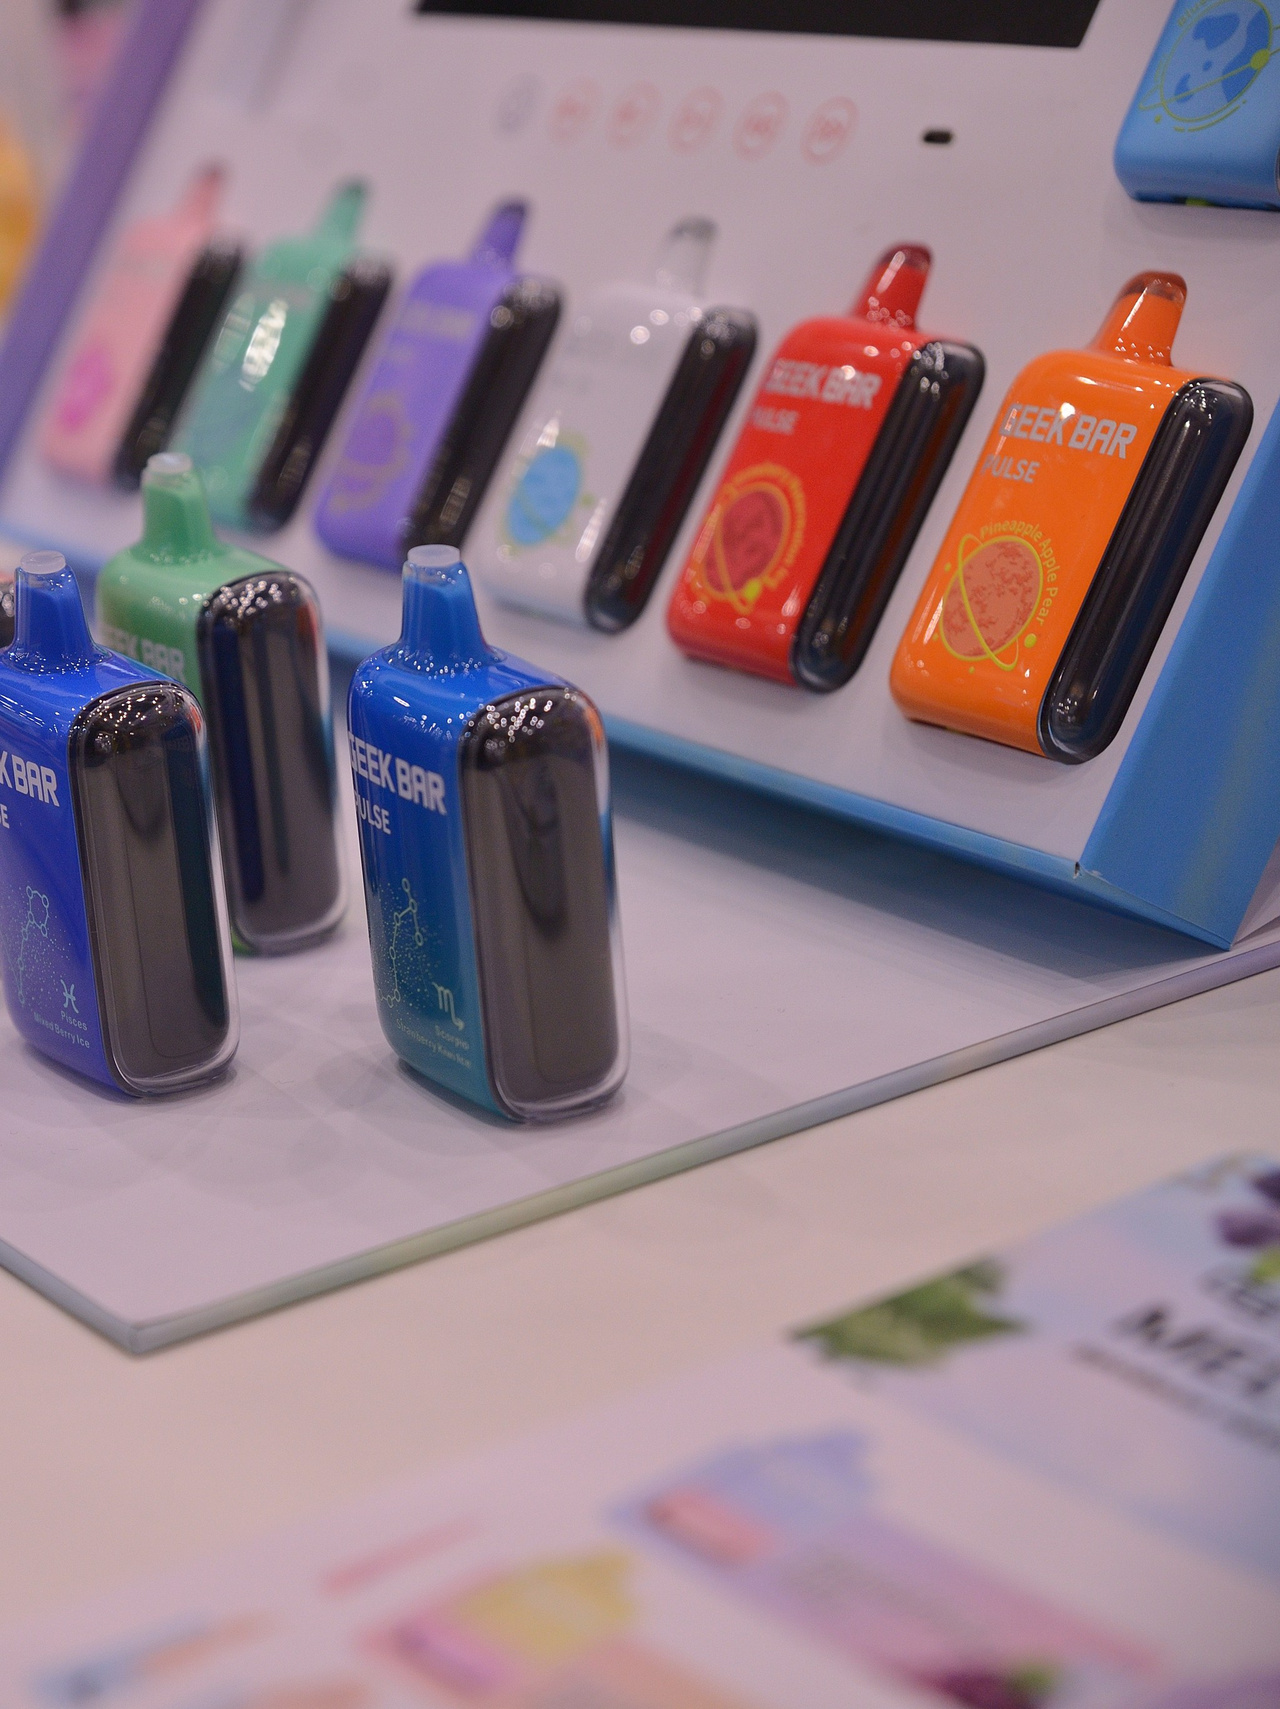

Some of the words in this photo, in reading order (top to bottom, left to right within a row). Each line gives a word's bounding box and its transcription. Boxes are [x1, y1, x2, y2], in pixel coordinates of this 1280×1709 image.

[821, 366, 883, 410] BAR
[999, 403, 1075, 446] GEEK
[1068, 414, 1138, 460] BAR
[980, 453, 1041, 485] PULSE
[979, 520, 1044, 543] Pineapple
[1038, 537, 1061, 583] Apple
[1035, 586, 1059, 627] Pear
[11, 754, 60, 807] BAR
[394, 756, 448, 816] BAR
[54, 1023, 76, 1044] Berry
[76, 1034, 90, 1049] Ice
[60, 1010, 88, 1032] Pisces
